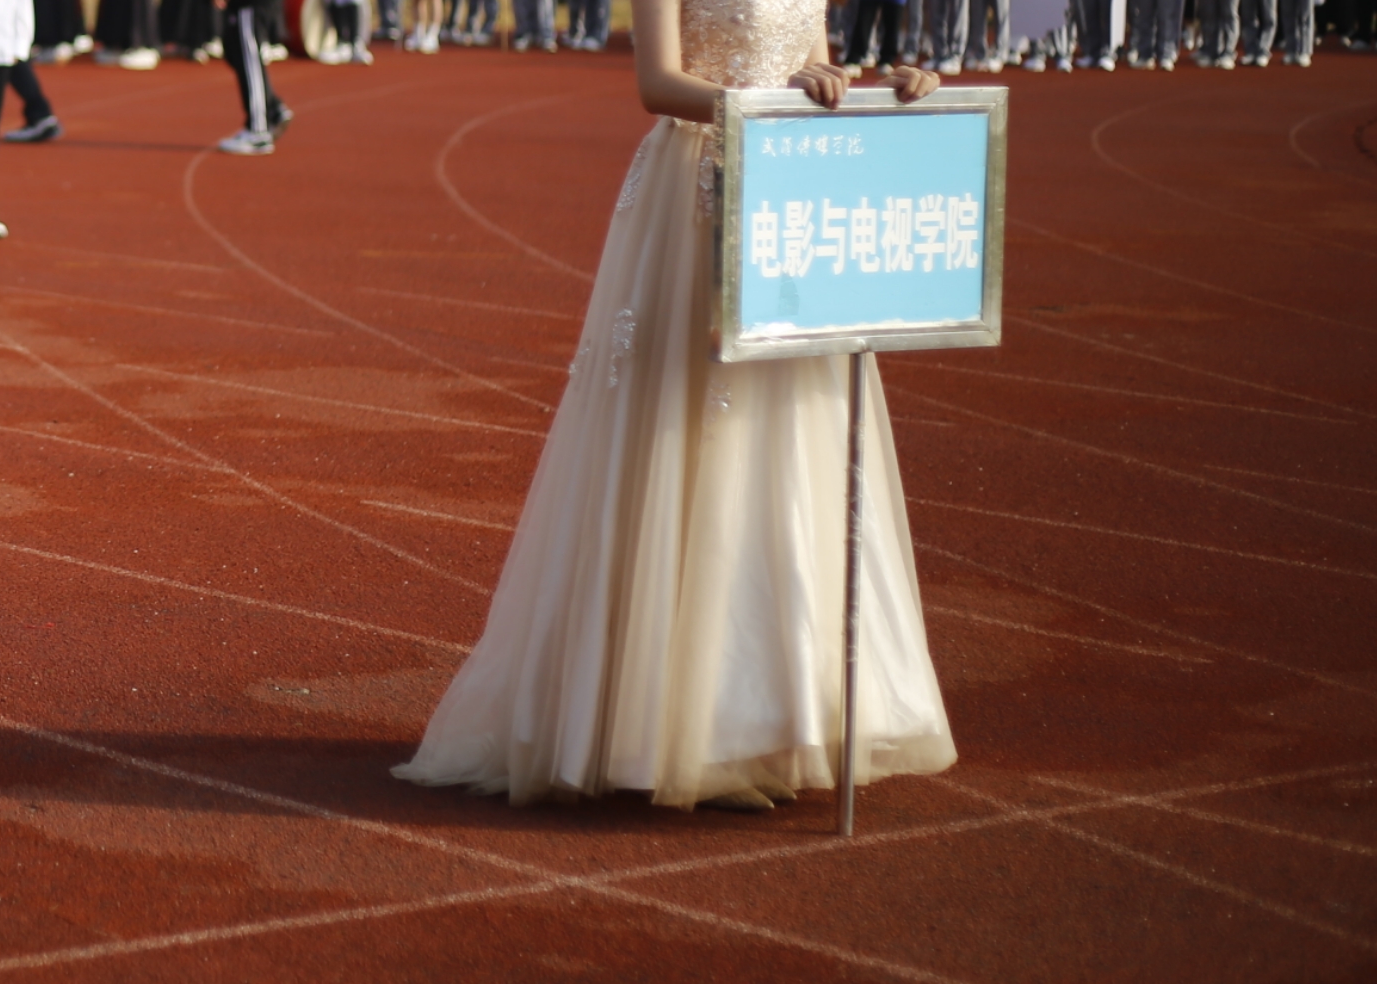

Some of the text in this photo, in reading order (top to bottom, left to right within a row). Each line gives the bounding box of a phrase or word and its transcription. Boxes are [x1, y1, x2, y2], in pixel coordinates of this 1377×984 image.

[751, 193, 979, 278] 电影与电视学院
